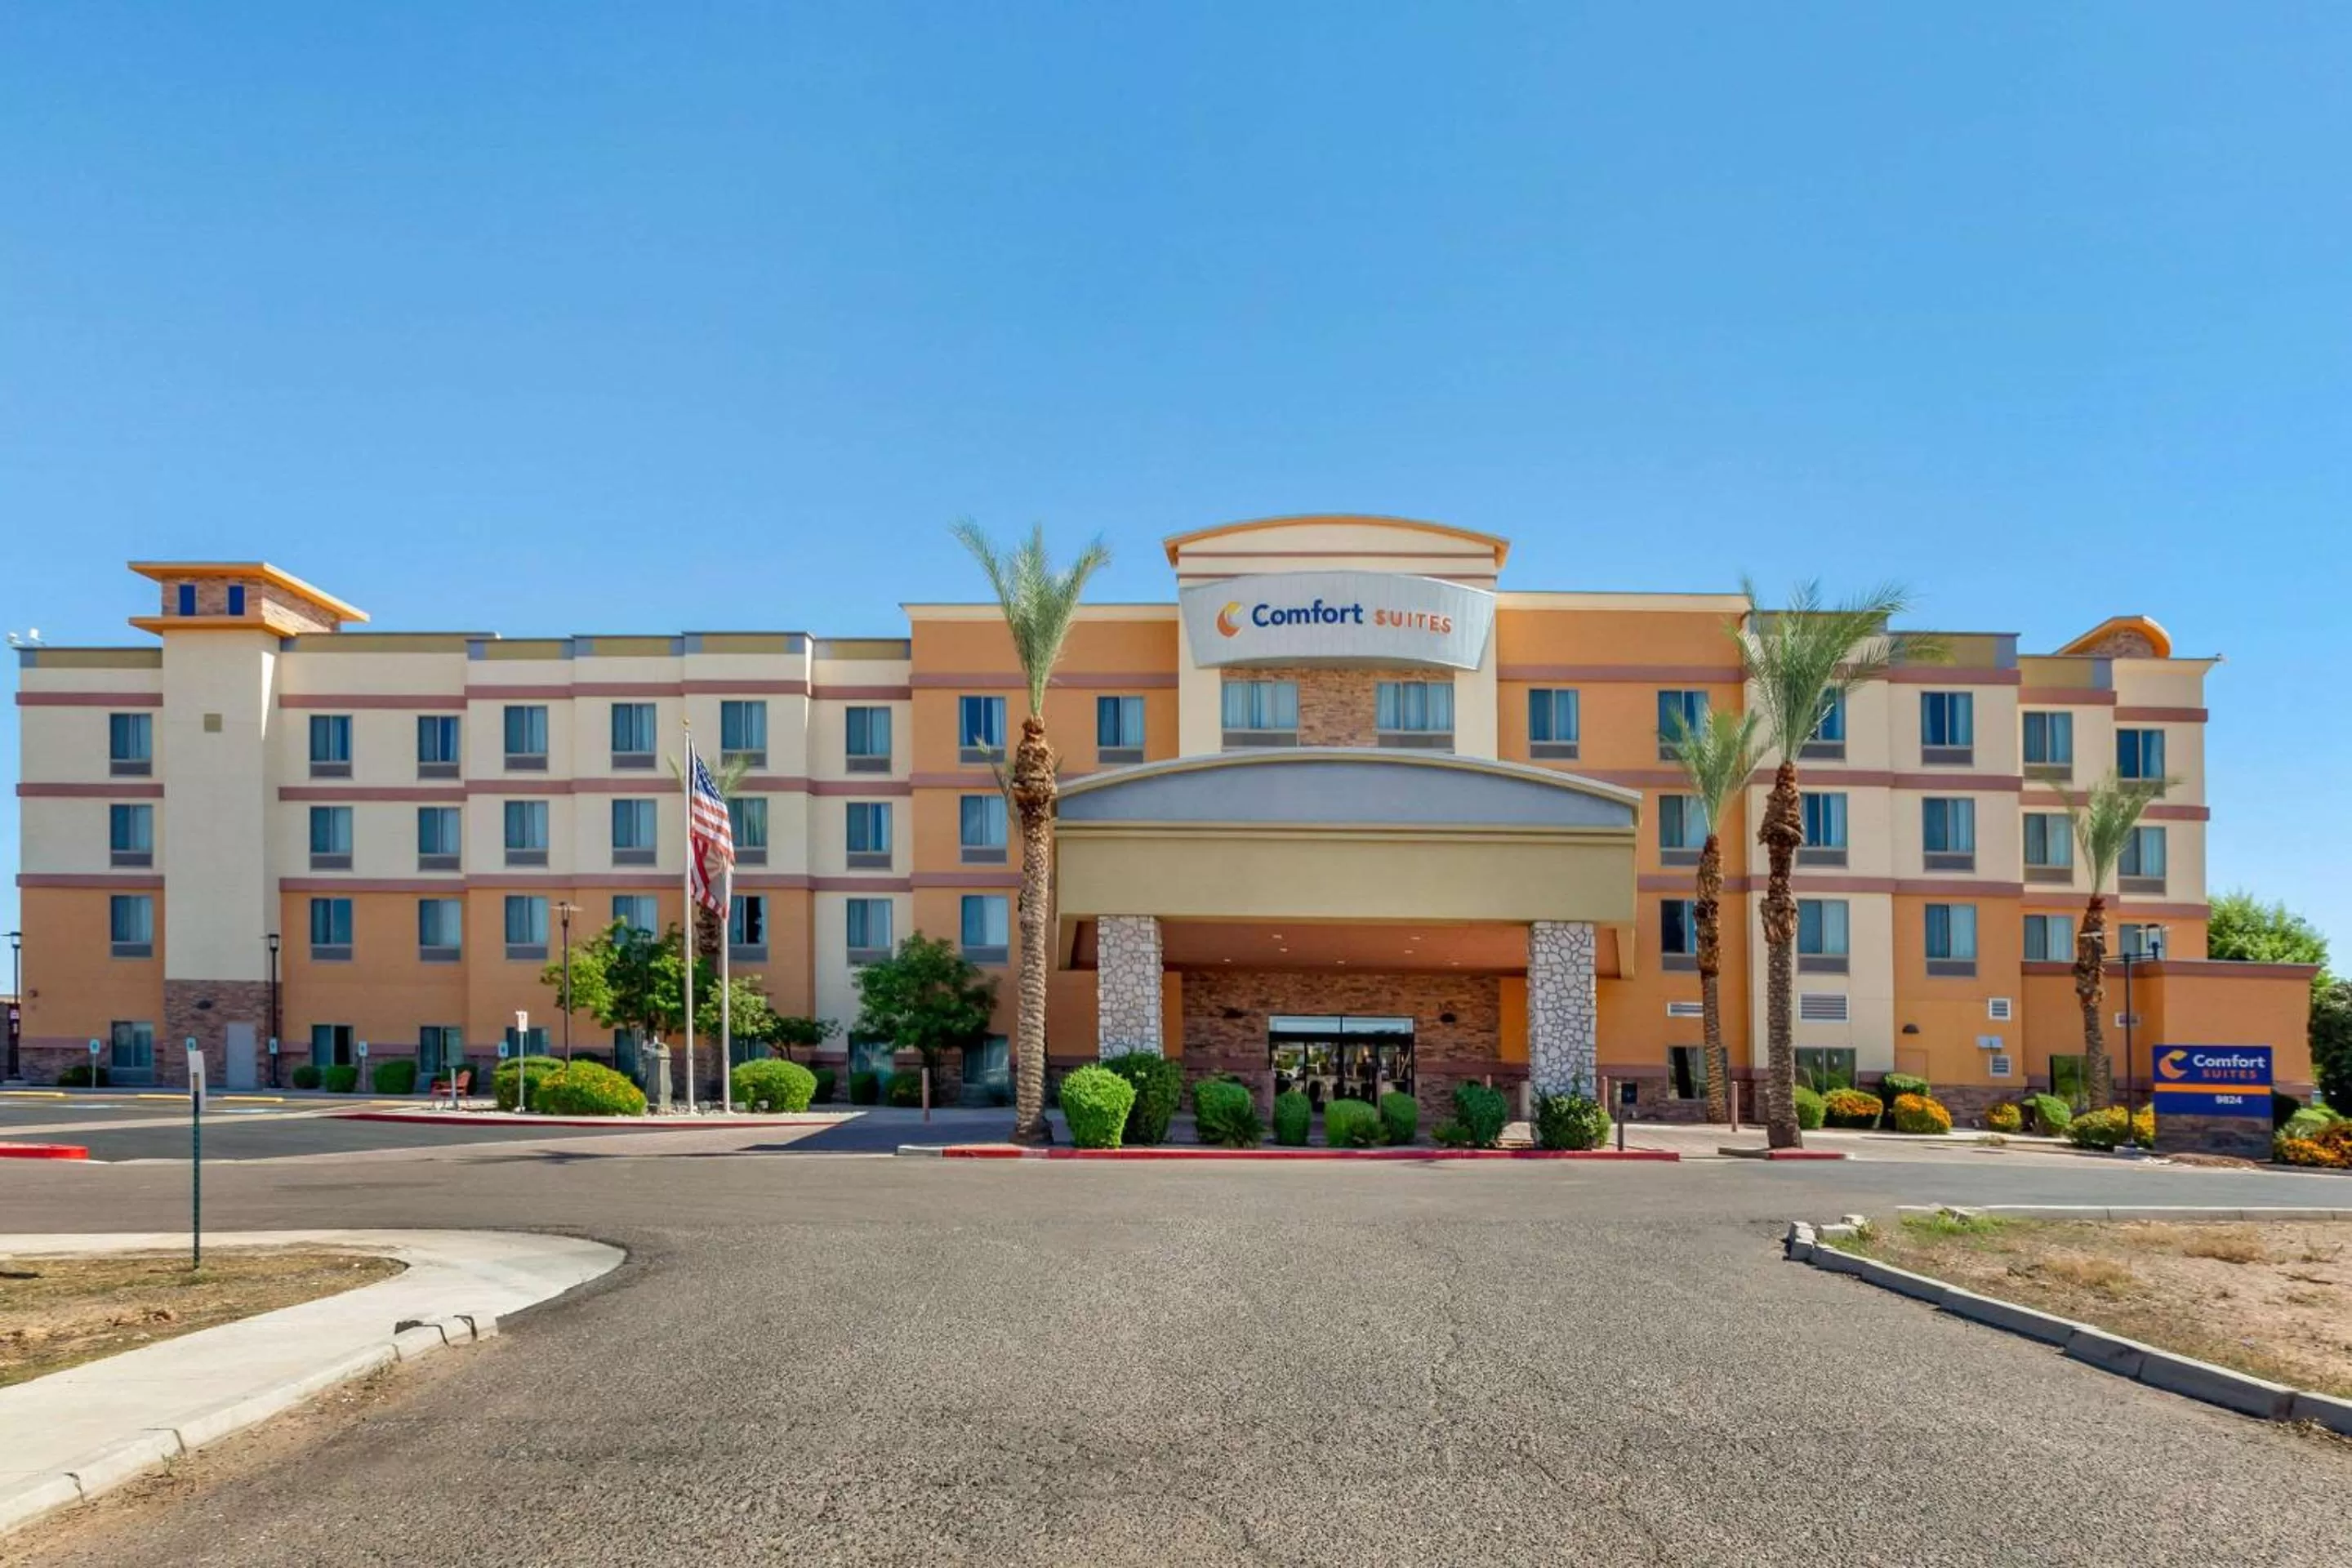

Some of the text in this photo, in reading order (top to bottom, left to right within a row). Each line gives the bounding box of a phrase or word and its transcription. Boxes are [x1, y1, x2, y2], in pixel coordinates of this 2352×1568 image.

[1252, 599, 1451, 634] Comfort SUITES
[2193, 1054, 2265, 1067] Comfort
[2202, 1070, 2256, 1079] SUITES
